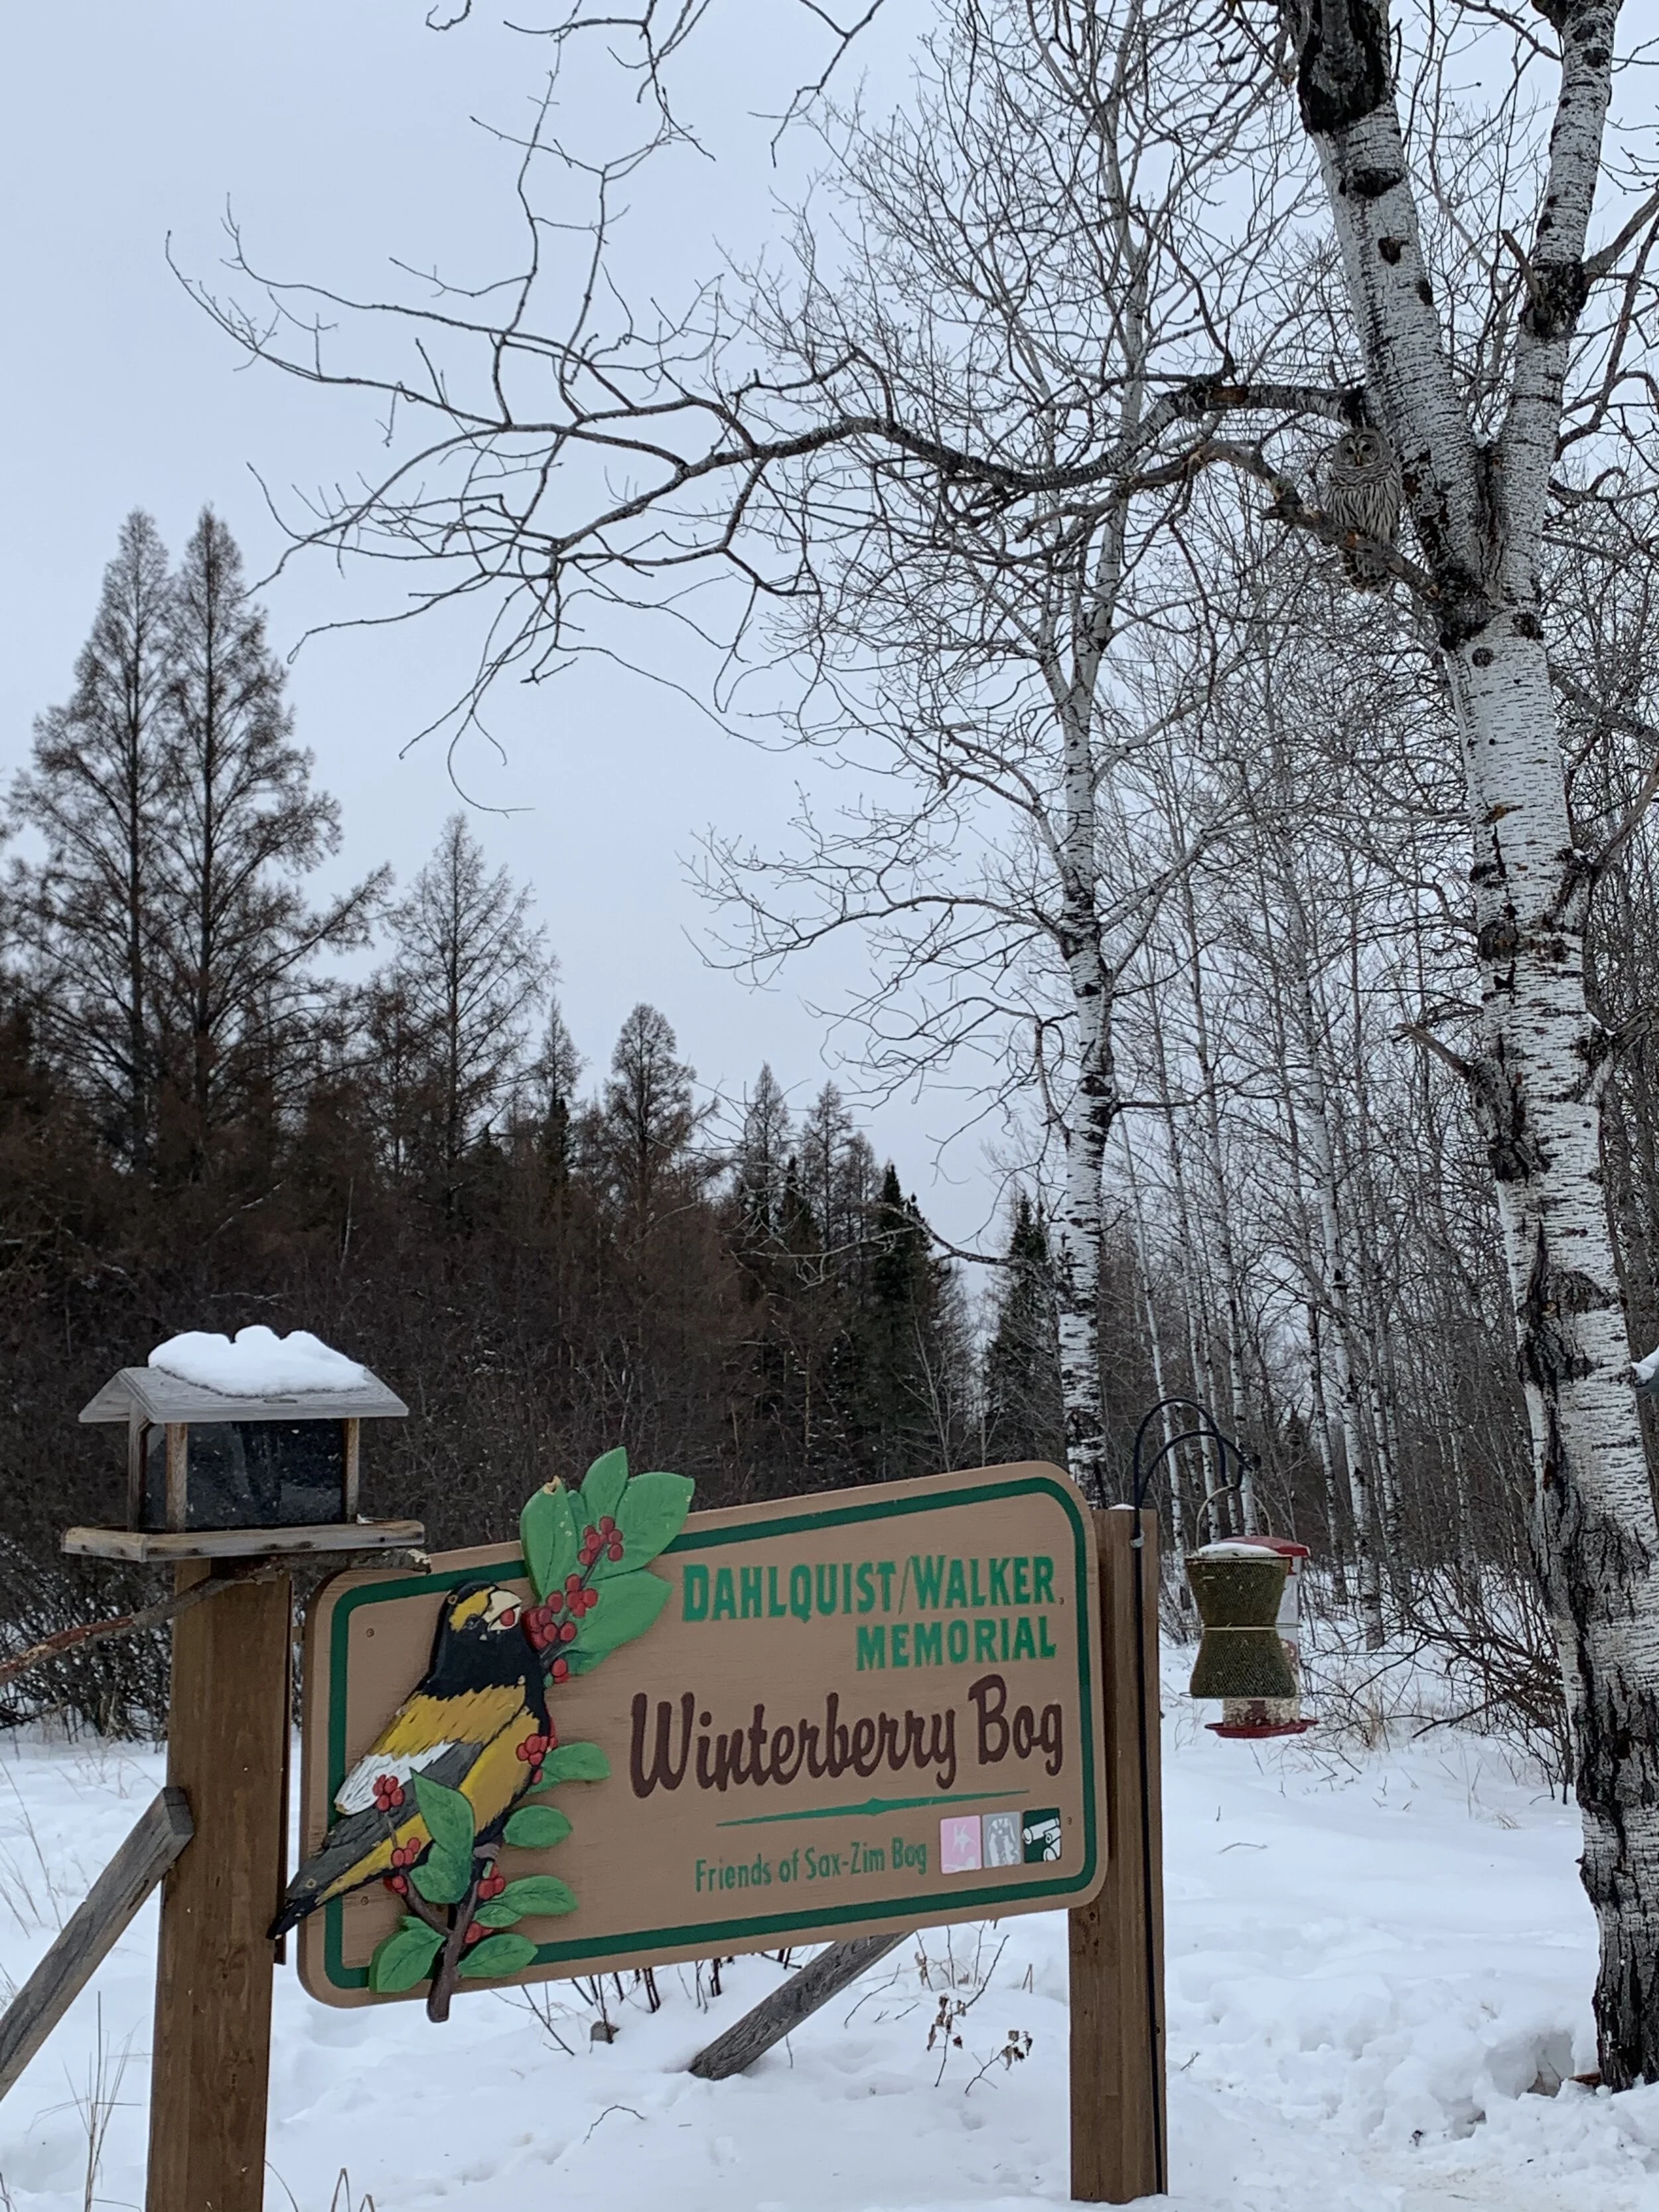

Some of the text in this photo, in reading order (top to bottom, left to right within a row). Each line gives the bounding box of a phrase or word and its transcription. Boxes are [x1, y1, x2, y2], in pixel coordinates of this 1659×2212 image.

[682, 1554, 1055, 1623] DAHLQUIST/WALKER
[855, 1616, 1056, 1671] MEMORIAL
[629, 1674, 1062, 1799] Winterberry Bog
[695, 1836, 928, 1893] Friends of Sax-Zim Bog
